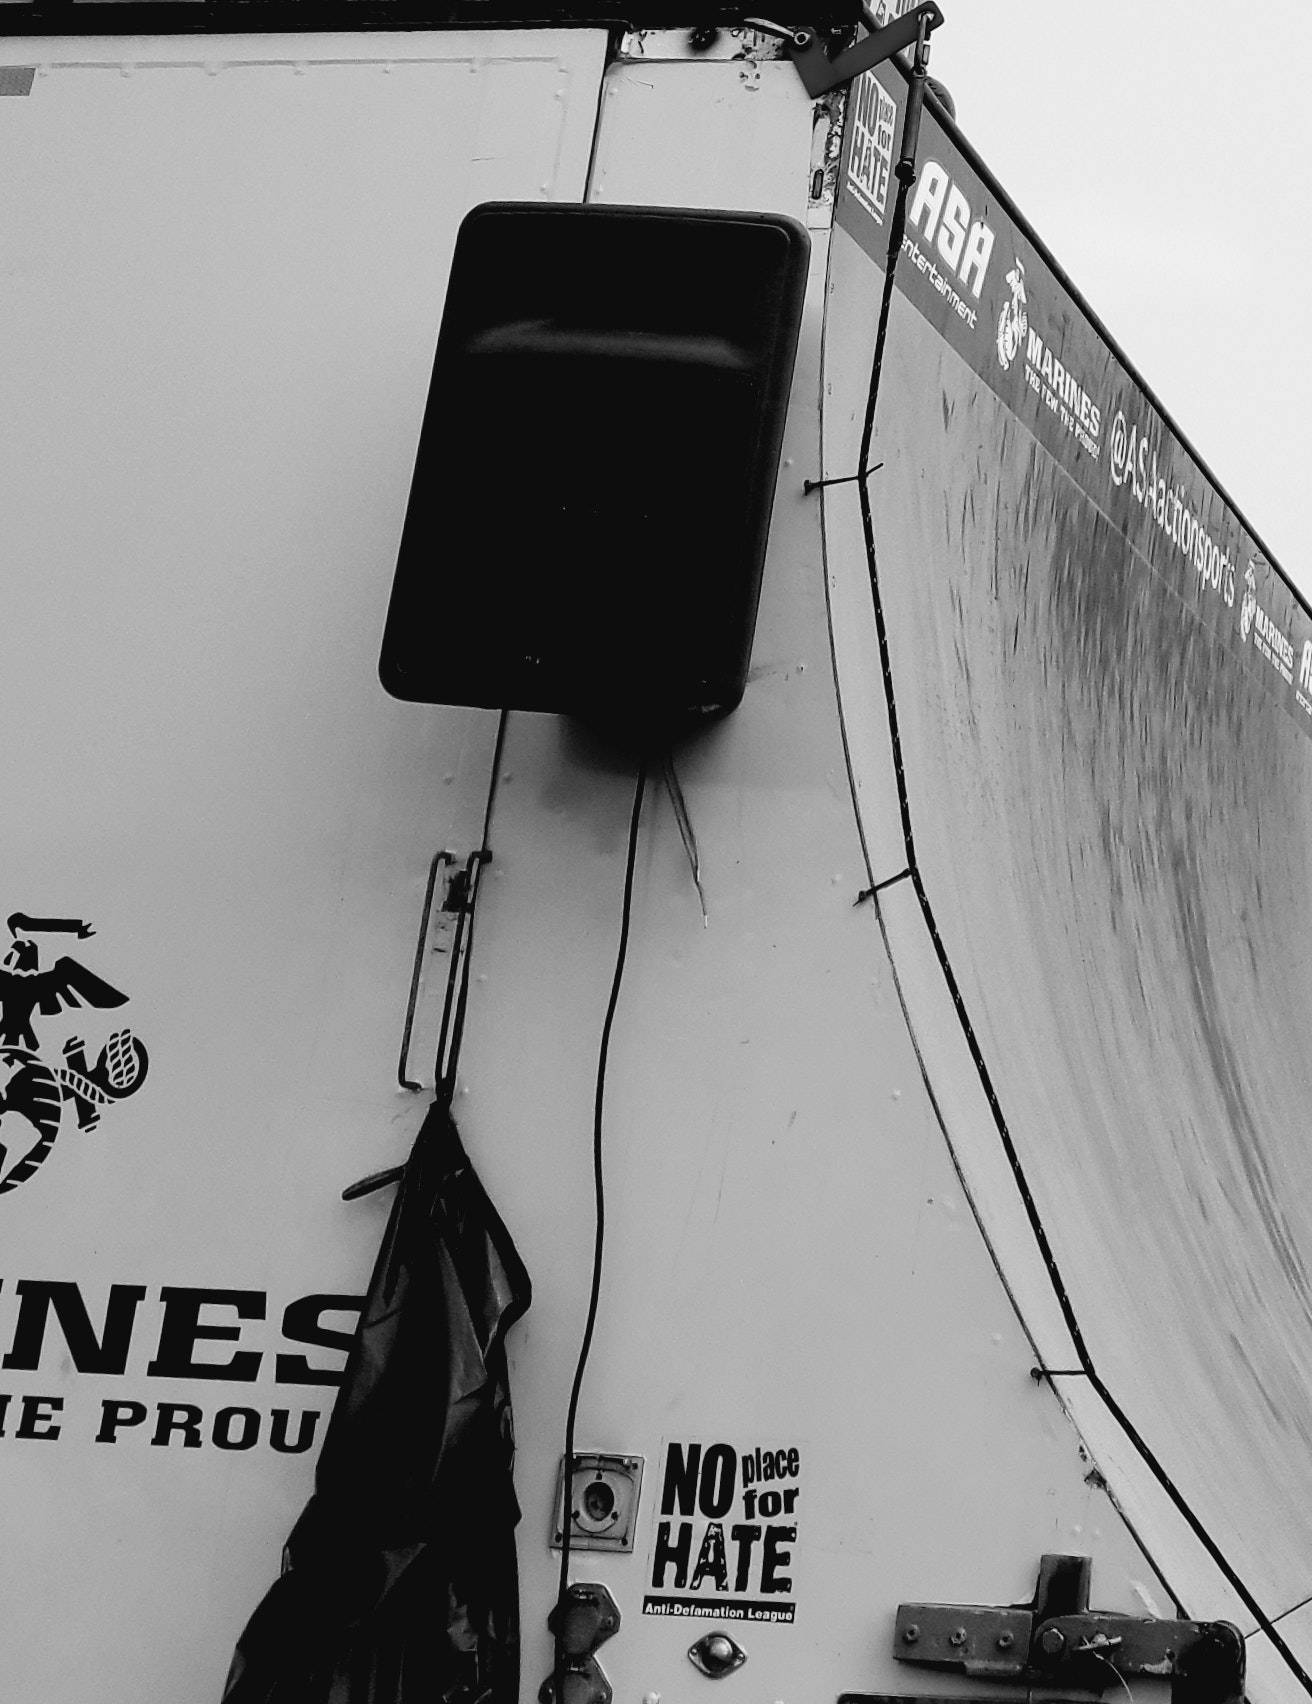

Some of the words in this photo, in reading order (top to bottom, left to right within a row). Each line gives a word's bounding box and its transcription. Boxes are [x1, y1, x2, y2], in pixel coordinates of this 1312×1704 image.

[908, 159, 996, 299] ASA
[1026, 326, 1101, 438] MARINES
[1110, 409, 1235, 608] @ASAactionsports
[0, 1278, 364, 1387] NES
[660, 1442, 737, 1519] NO
[741, 1447, 800, 1489] place
[742, 1487, 800, 1521] for
[651, 1521, 798, 1594] HATE
[644, 1603, 744, 1619] Anti-Defamation
[747, 1608, 793, 1623] League
